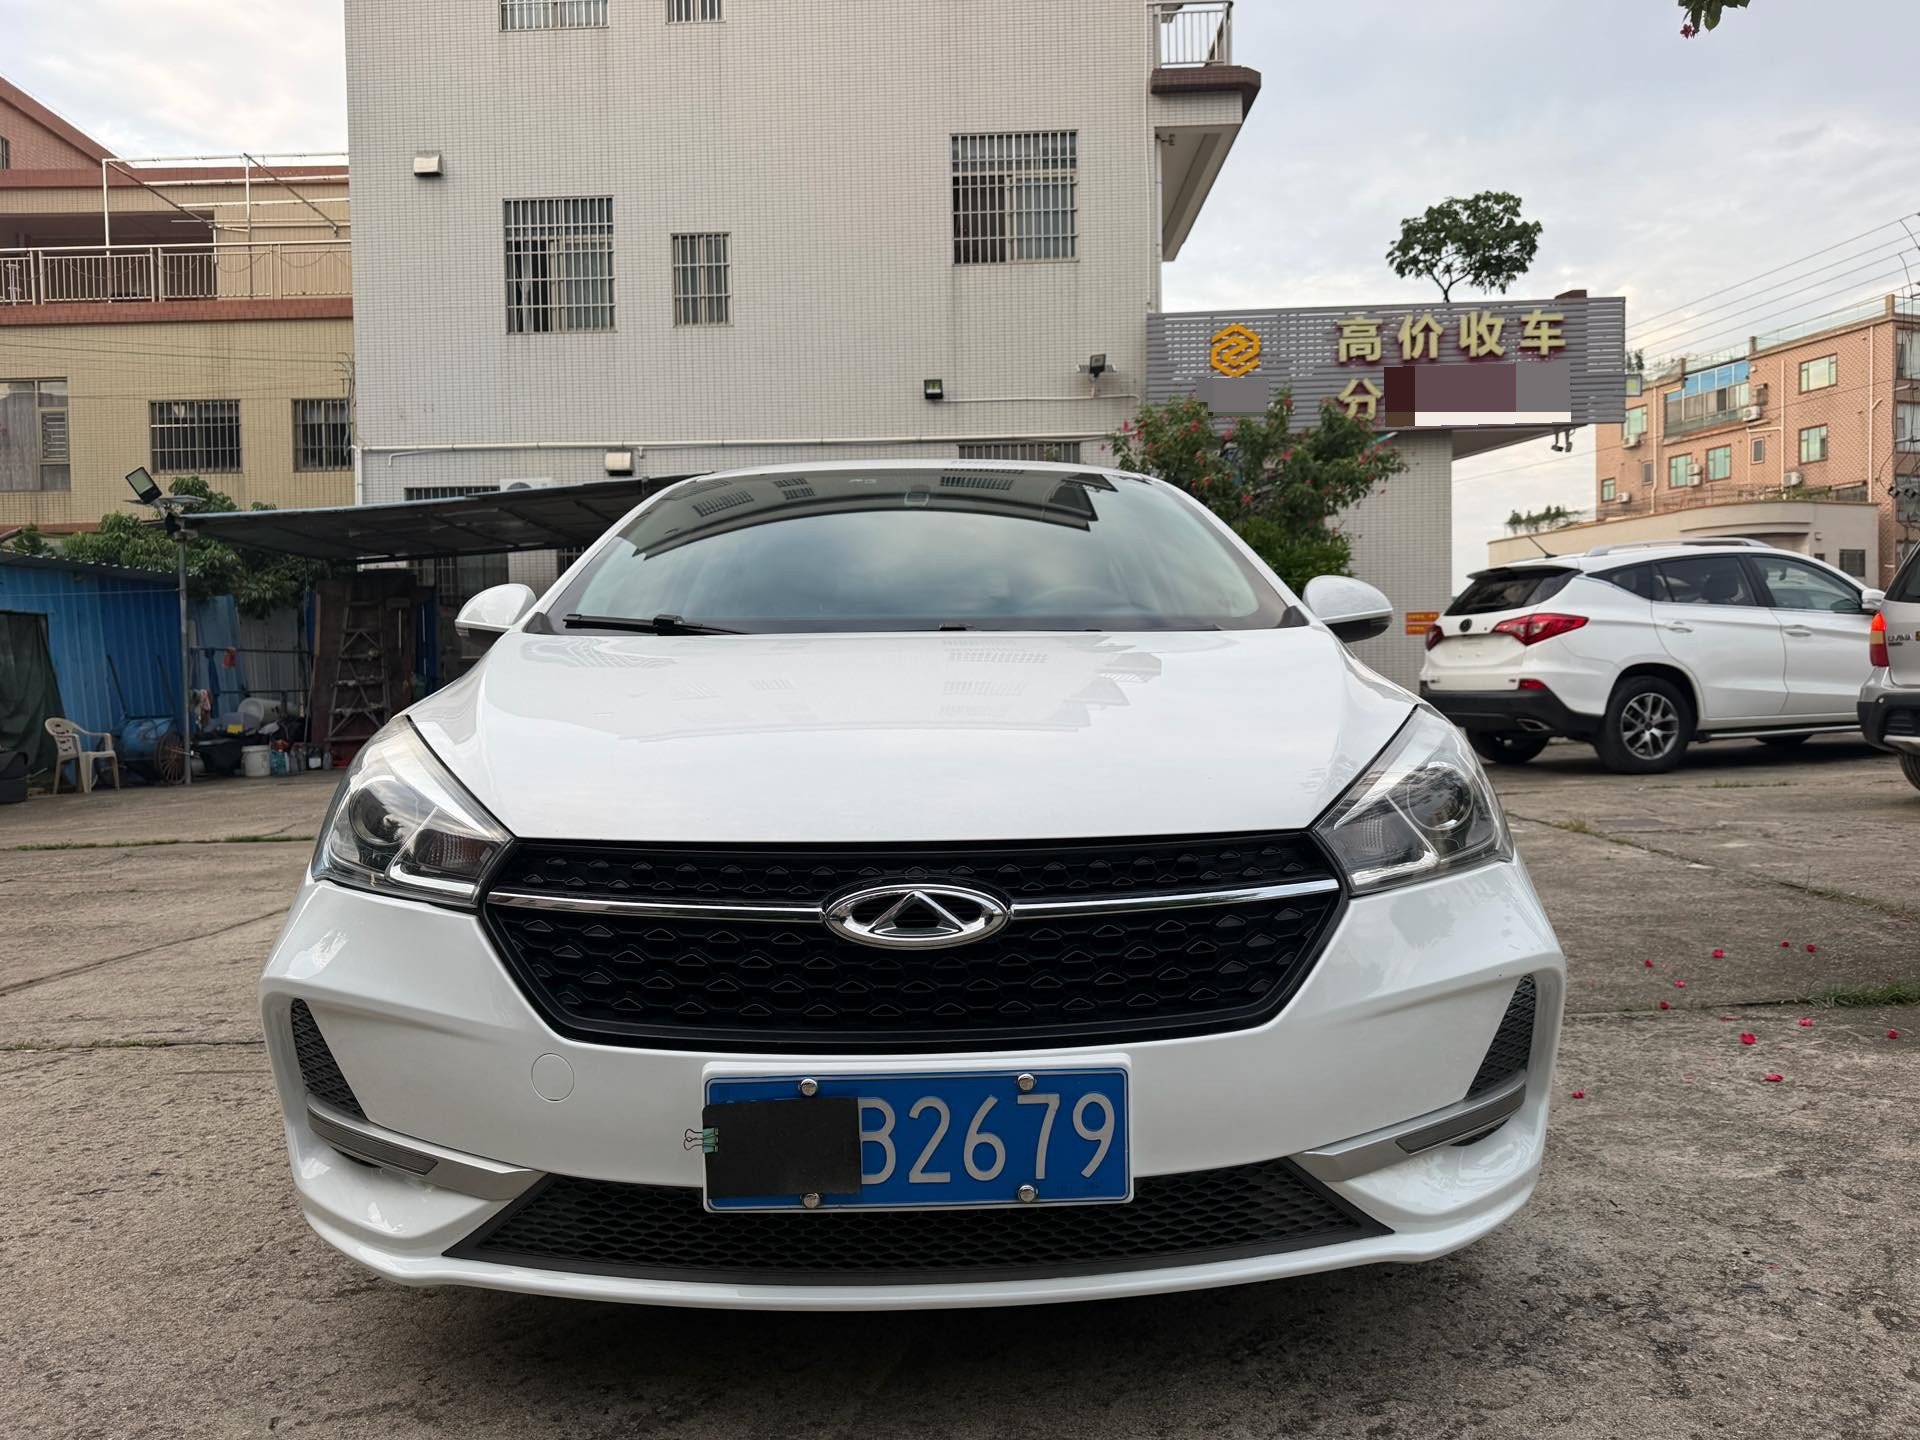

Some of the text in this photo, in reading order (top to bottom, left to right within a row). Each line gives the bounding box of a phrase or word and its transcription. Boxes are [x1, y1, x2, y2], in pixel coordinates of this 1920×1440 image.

[1337, 309, 1566, 361] 高价收车
[858, 1093, 1115, 1185] B2679
